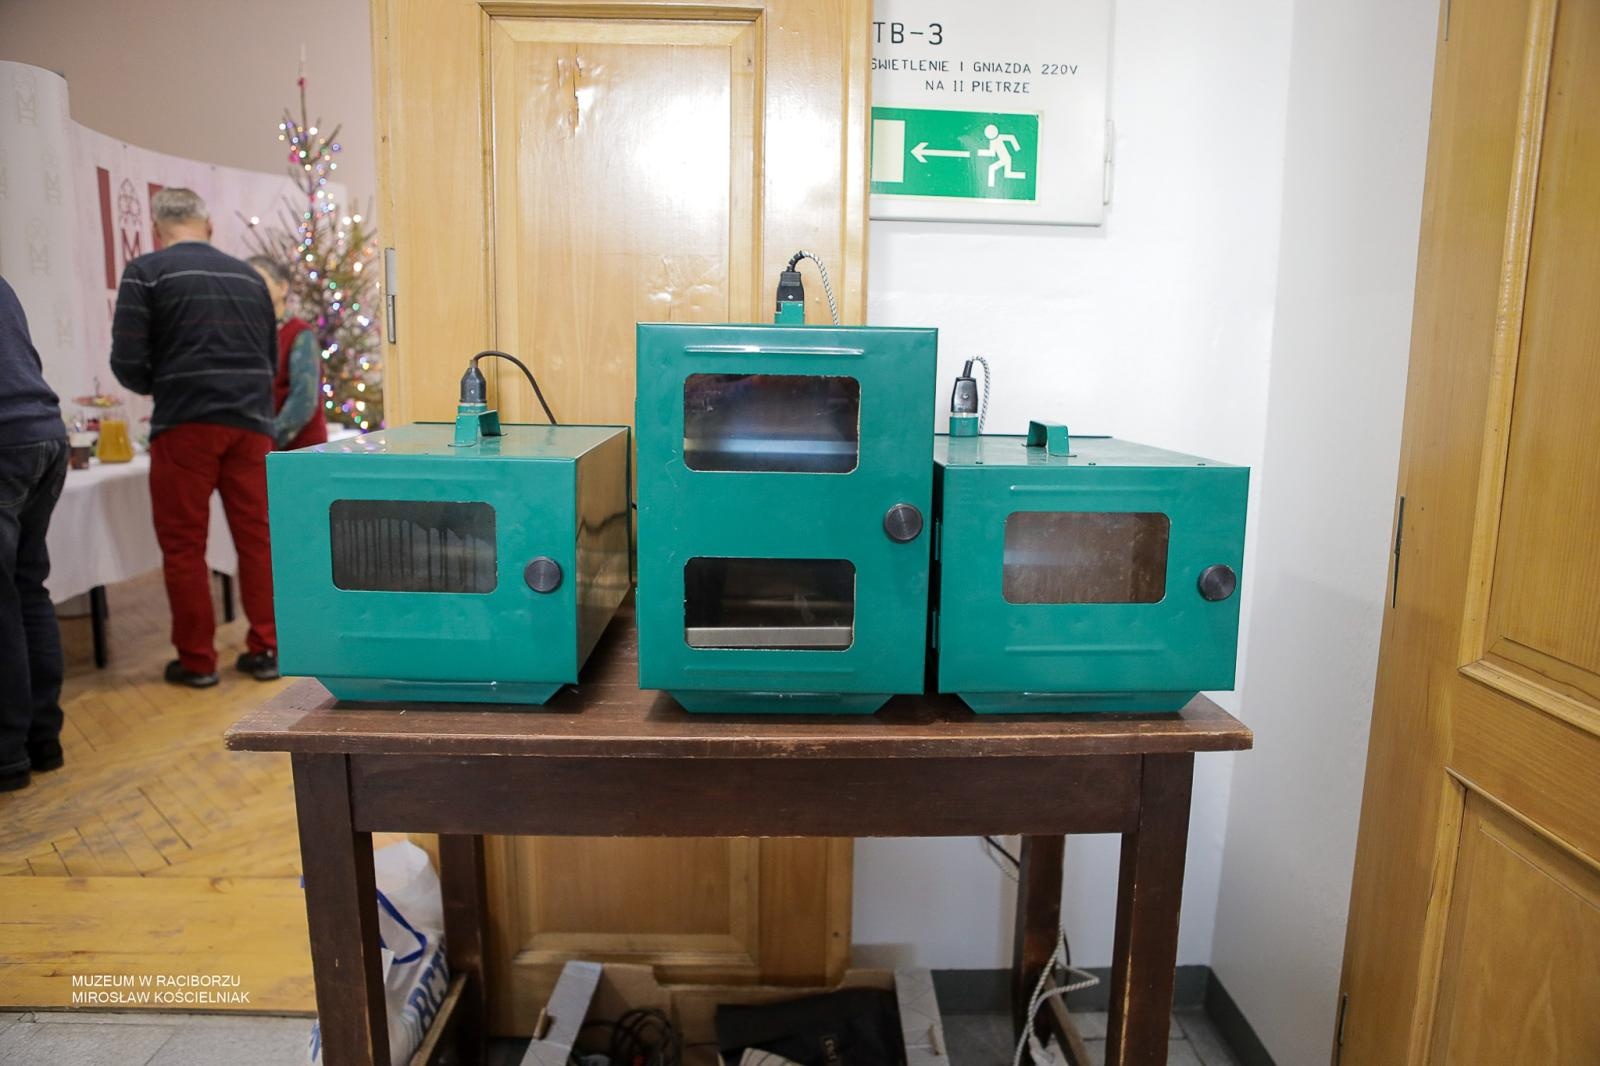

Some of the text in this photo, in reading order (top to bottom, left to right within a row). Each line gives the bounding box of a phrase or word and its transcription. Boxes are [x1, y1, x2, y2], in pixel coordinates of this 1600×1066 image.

[973, 61, 1032, 74] GNIAZDA
[1041, 63, 1079, 75] 220V
[925, 79, 1031, 94] NA II PIETRZE
